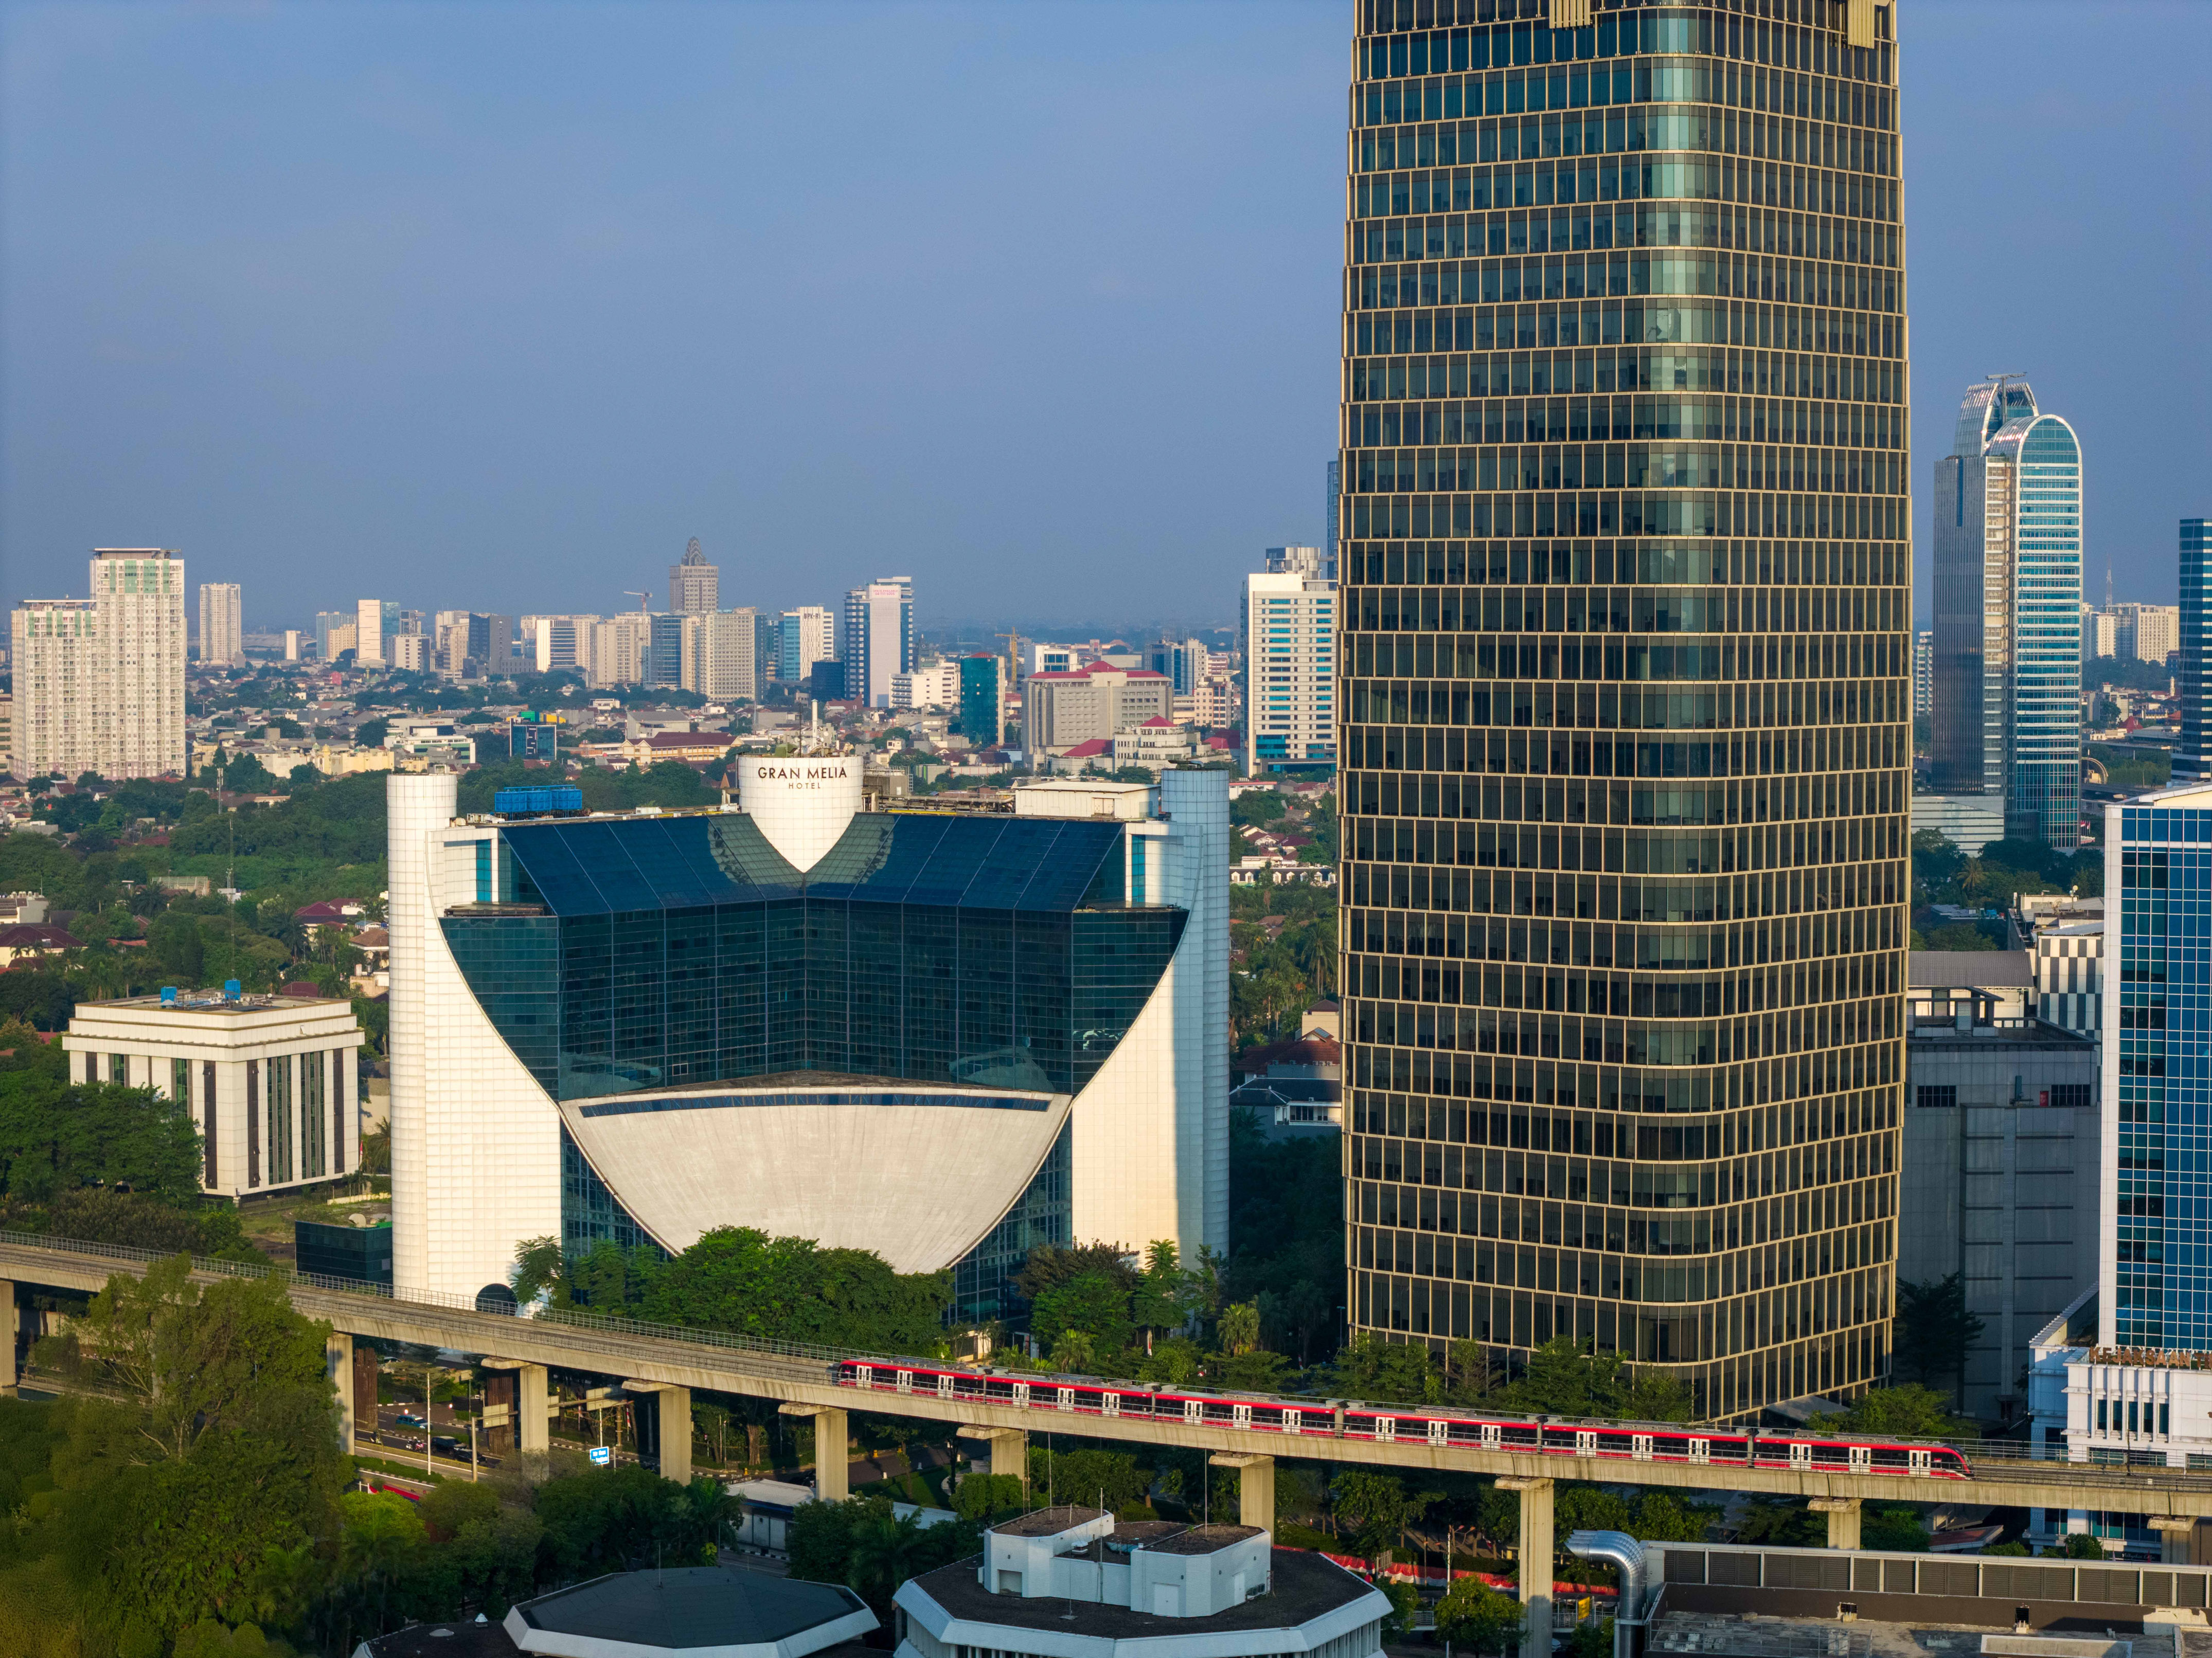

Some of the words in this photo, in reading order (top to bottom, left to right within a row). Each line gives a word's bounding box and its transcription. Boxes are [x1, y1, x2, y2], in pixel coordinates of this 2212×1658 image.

[758, 767, 799, 779] GRAN
[808, 767, 847, 778] MELIA
[2089, 1346, 2191, 1367] KEJAKSAAN
